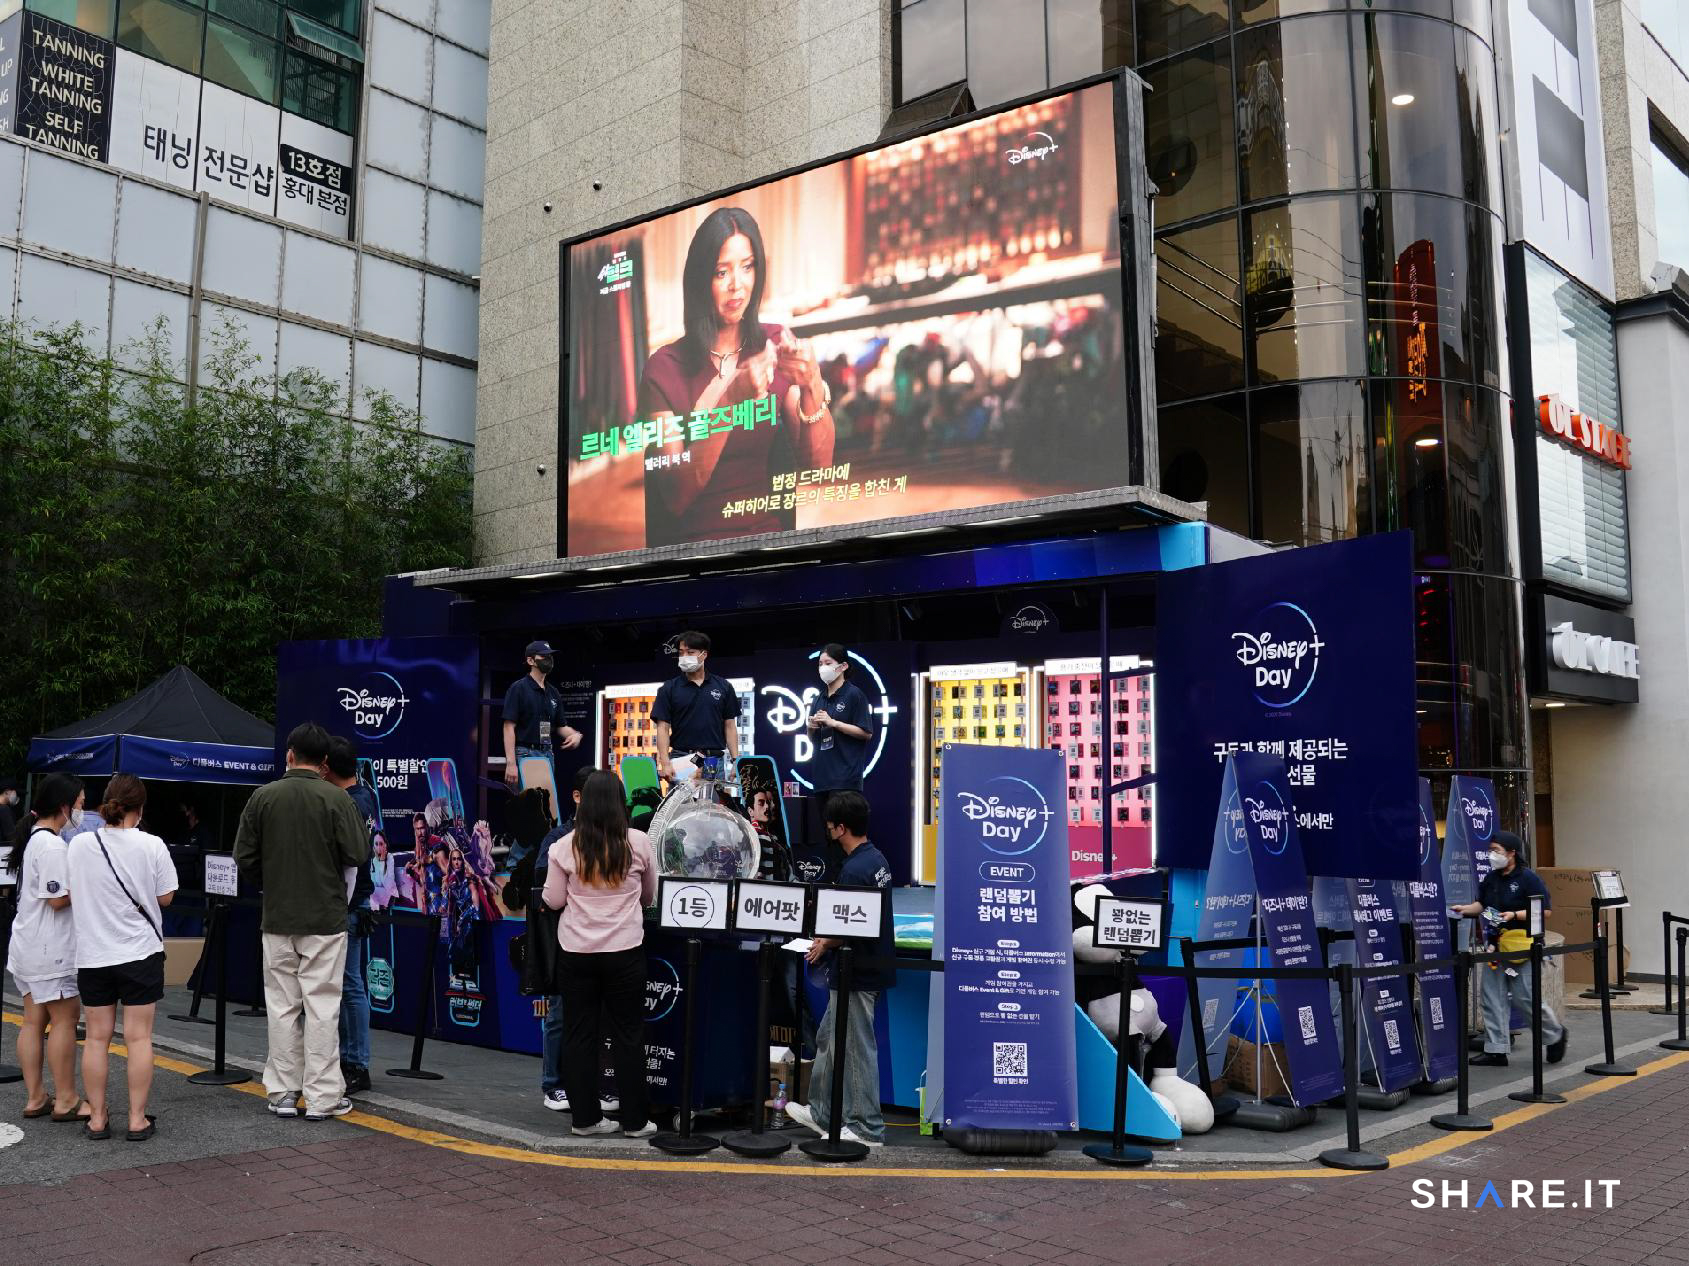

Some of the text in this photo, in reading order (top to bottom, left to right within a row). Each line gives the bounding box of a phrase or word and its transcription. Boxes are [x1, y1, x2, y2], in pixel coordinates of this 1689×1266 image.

[33, 29, 104, 69] TANNING
[41, 60, 94, 92] WHITE
[30, 76, 102, 114] TANNING
[45, 112, 83, 134] SELF
[26, 124, 99, 160] TANNING
[144, 124, 275, 198] 태닝 전문샵
[1005, 143, 1059, 165] Disney+
[288, 152, 342, 189] 13호점
[282, 177, 348, 216] 홍대 본점
[580, 427, 620, 460] 르네
[688, 394, 777, 441] 골즈베리
[772, 463, 850, 491] 법정 드라마에
[721, 475, 908, 518] 슈퍼히어로 장르의 특징을 합친 게
[1010, 616, 1049, 630] Disney+
[1231, 632, 1325, 669] Disney+
[1255, 666, 1292, 689] Day
[337, 687, 410, 714] Disney+
[355, 711, 383, 727] Day
[1288, 738, 1348, 760] 제공되는
[223, 760, 249, 770] EVENT
[250, 763, 257, 771] &
[1287, 764, 1316, 786] 선물
[376, 774, 409, 790] 500원
[957, 792, 1055, 829] Disney+
[1244, 798, 1289, 829] Disney+
[1461, 797, 1493, 821] Disney+
[982, 821, 1021, 842] Day
[1260, 824, 1278, 843] Day
[1071, 849, 1117, 862] Disney+
[990, 866, 1024, 878] EVENT
[979, 887, 1036, 905] 랜덤뽑기
[678, 897, 708, 918] 1등
[744, 897, 800, 922] 에어팟
[832, 904, 868, 924] 맥스
[977, 905, 1038, 923] 참여 방법
[1104, 926, 1156, 945] 랜덤뽑기
